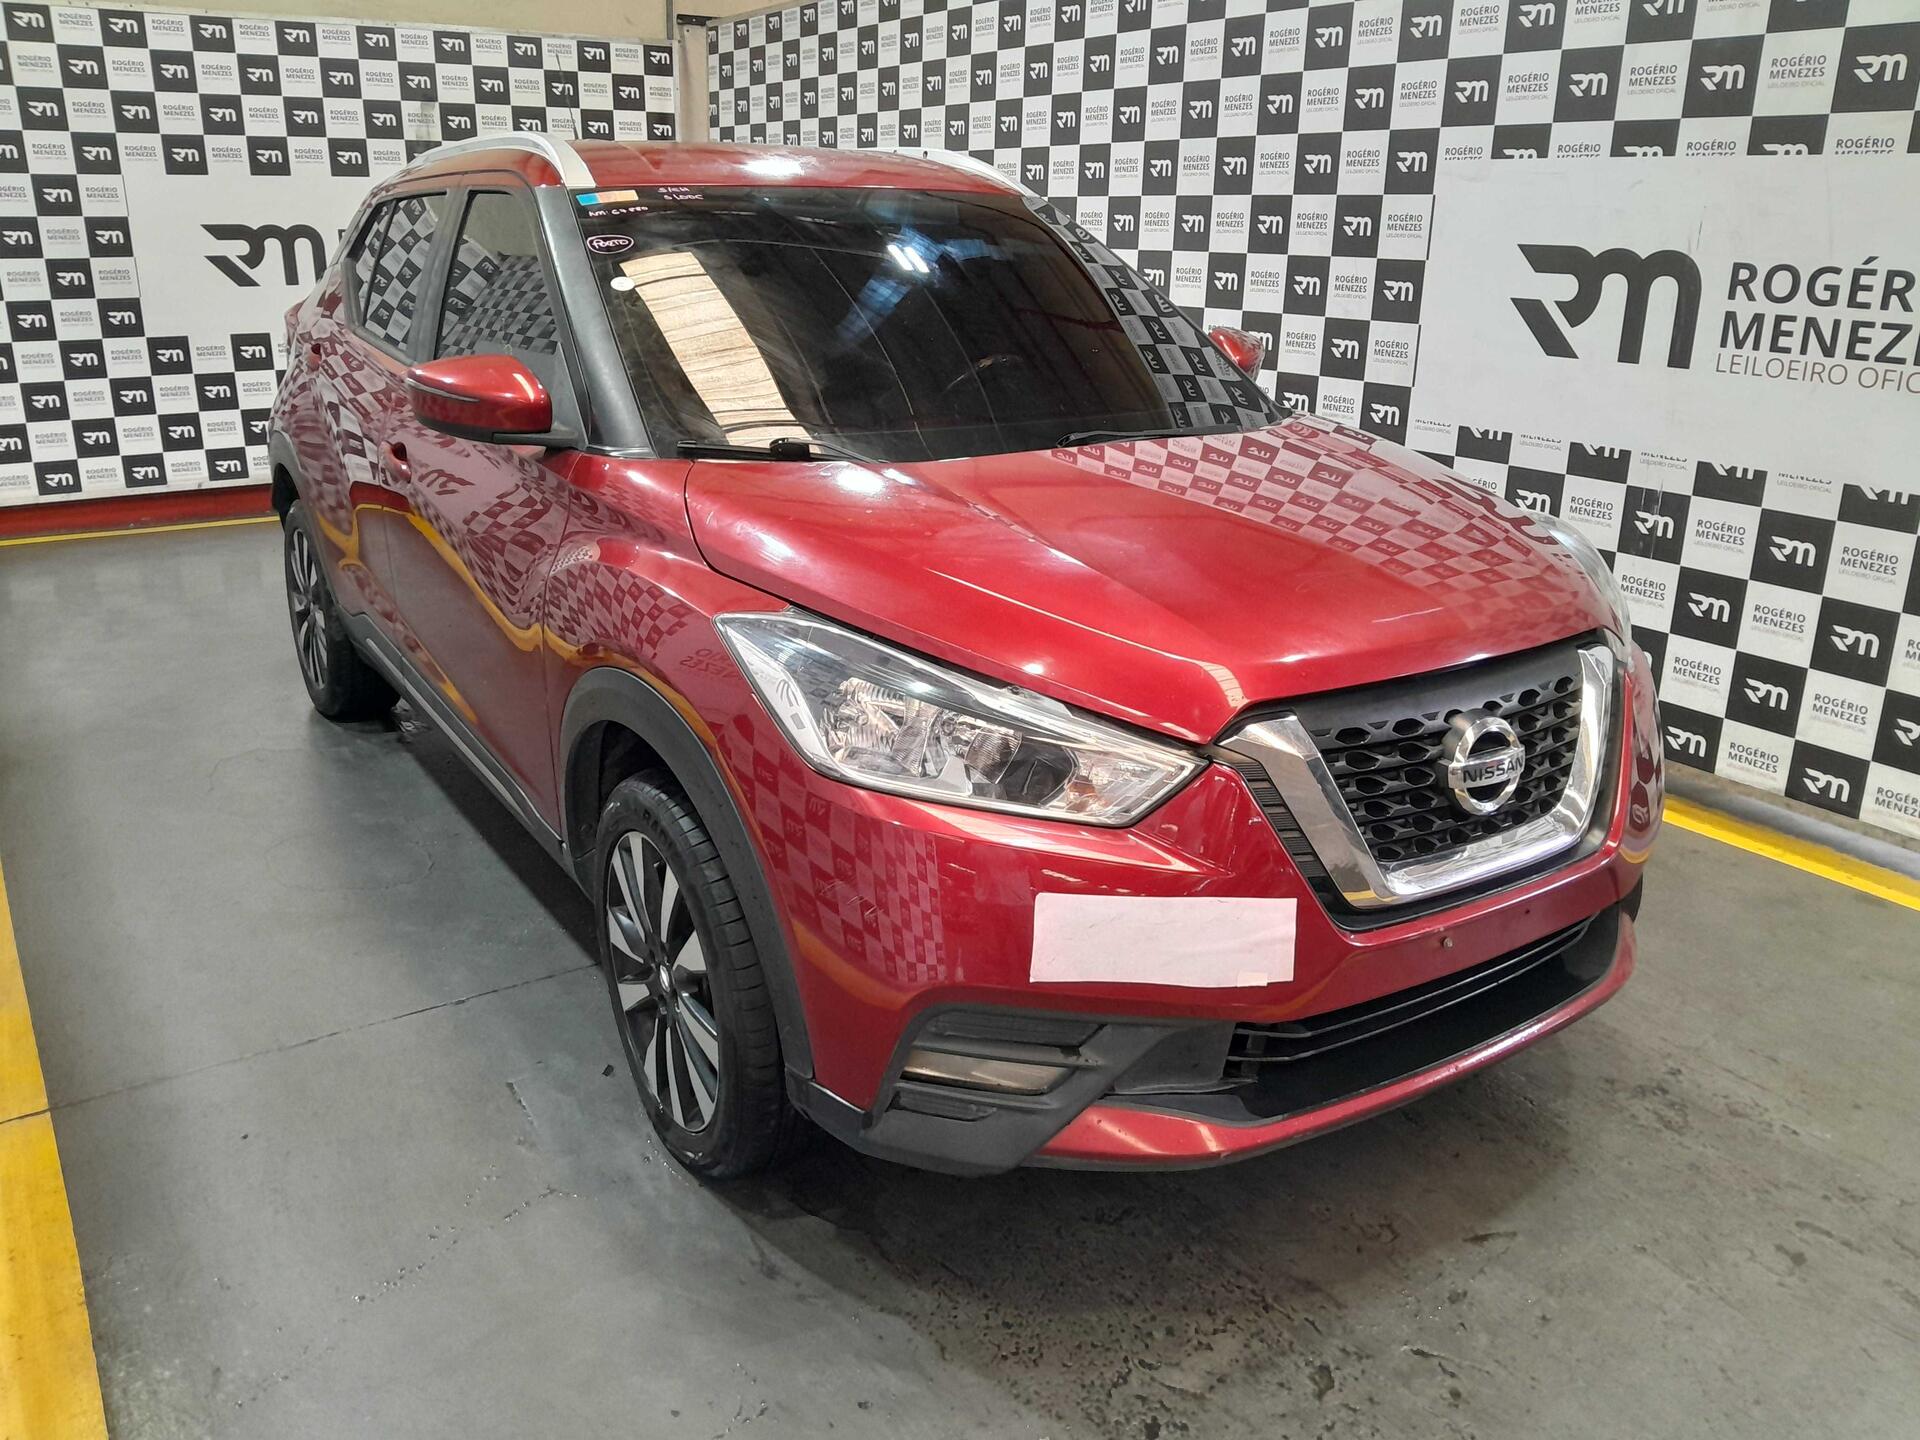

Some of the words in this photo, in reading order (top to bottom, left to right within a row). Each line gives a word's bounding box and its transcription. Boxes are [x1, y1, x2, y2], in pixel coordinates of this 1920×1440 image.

[1459, 4, 1500, 17] ROGÉRIO
[1574, 3, 1620, 15] MENEZES
[1358, 16, 1393, 28] ROGÉRIO
[1459, 14, 1499, 26] MENEZES
[1357, 26, 1392, 36] MENEZES
[1268, 36, 1299, 46] MENEZES
[1189, 45, 1217, 55] MENEZES
[1770, 54, 1826, 67] ROGÉRIO
[1629, 63, 1678, 76] ROGÉRIO
[1769, 66, 1825, 78] MENEZES
[1507, 71, 1549, 83] ROGÉRIO
[1628, 75, 1676, 86] MENEZES
[1400, 79, 1437, 90] ROGÉRIO
[1506, 82, 1548, 93] MENEZES
[1306, 86, 1339, 97] ROGÉRIO
[1399, 89, 1436, 99] MENEZES
[1223, 102, 1252, 110] MENEZES
[1306, 96, 1338, 105] MENEZES
[1150, 107, 1176, 115] MENEZES
[1557, 141, 1601, 153] ROGÉRIO
[1685, 138, 1737, 150] ROGÉRIO
[1835, 135, 1894, 148] ROGÉRIO
[1346, 148, 1380, 158] ROGÉRIO
[1444, 144, 1483, 155] ROGÉRIO
[1259, 160, 1289, 168] MENEZES
[1345, 158, 1379, 167] MENEZES
[1387, 212, 1423, 222] ROGÉRIO
[1295, 221, 1327, 229] MENEZES
[1386, 223, 1422, 231] MENEZES
[1249, 278, 1279, 287] MENEZES
[1334, 274, 1367, 284] ROGÉRIO
[1333, 283, 1366, 292] MENEZES
[1285, 339, 1315, 349] MENEZES
[1374, 339, 1409, 350] ROGÉRIO
[1719, 310, 1920, 367] MENEZ
[1373, 348, 1408, 358] MENEZES
[1715, 353, 1848, 385] LEILOEIRO
[1322, 394, 1355, 405] ROGÉRIO
[1322, 402, 1354, 413] MENEZES
[1570, 495, 1613, 511] ROGÉRIO
[1569, 505, 1612, 520] MENEZES
[1696, 518, 1746, 535] ROGÉRIO
[1695, 529, 1744, 545] MENEZES
[1841, 545, 1899, 564] ROGÉRIO
[1839, 557, 1897, 575] MENEZES
[1621, 574, 1666, 591] ROGÉRIO
[1619, 583, 1665, 601] MENEZES
[1753, 603, 1806, 623] ROGÉRIO
[1752, 614, 1804, 633] MENEZES
[1673, 656, 1721, 675] ROGÉRIO
[1672, 665, 1720, 685] MENEZES
[1813, 693, 1868, 714] ROGÉRIO
[1811, 703, 1866, 725] MENEZES
[1728, 742, 1779, 763] ROGÉRIO
[1727, 751, 1777, 773] MENEZES
[1463, 758, 1524, 783] NISSAN
